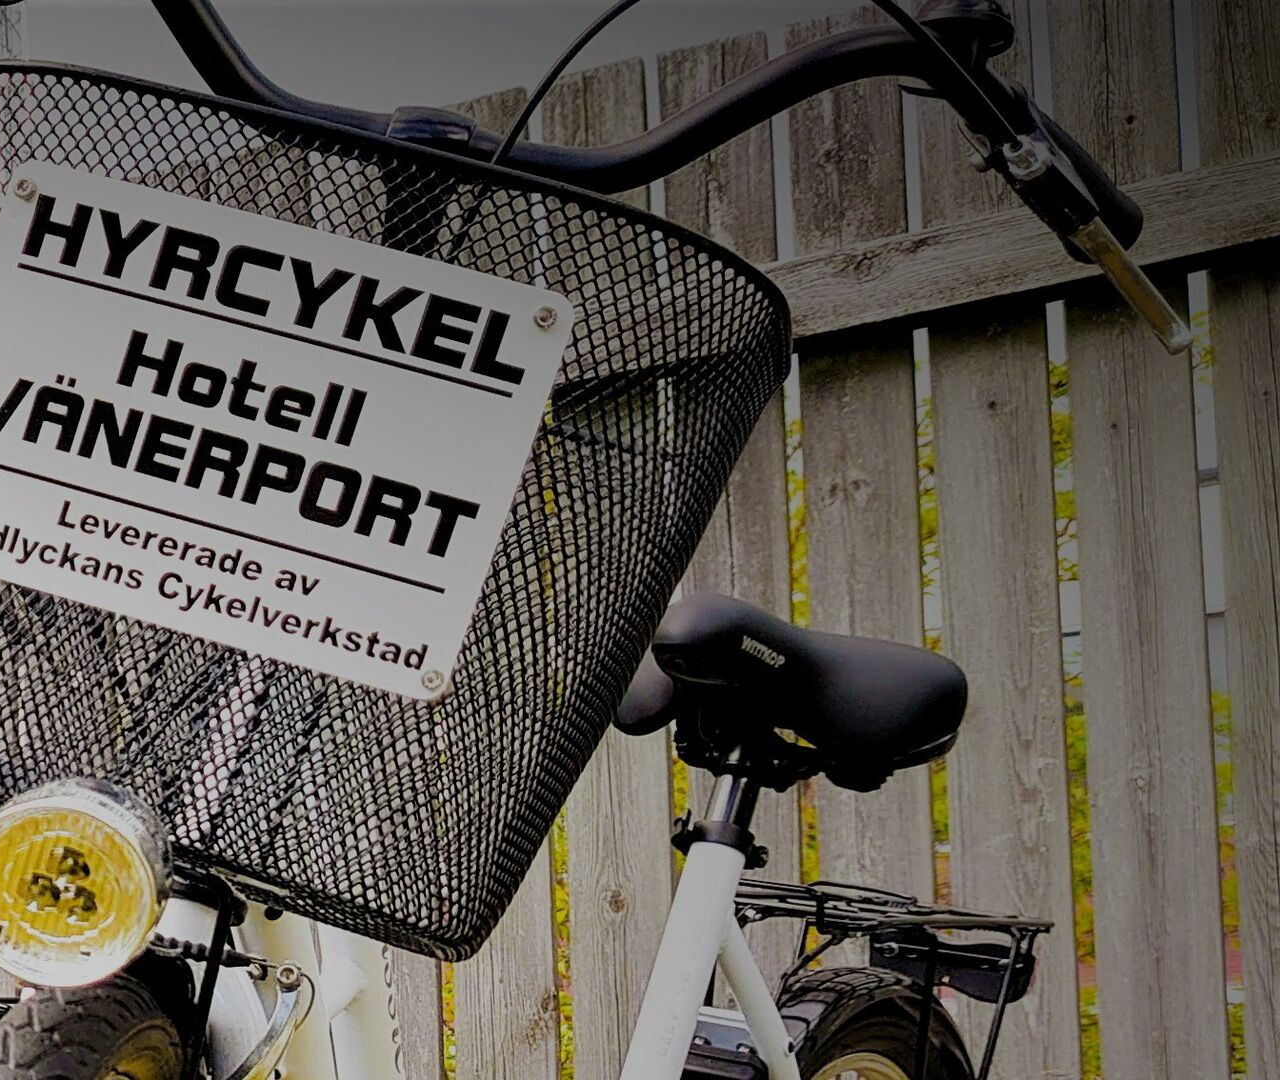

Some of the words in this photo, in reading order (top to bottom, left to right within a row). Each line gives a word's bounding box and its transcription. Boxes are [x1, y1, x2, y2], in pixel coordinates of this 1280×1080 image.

[23, 194, 526, 385] HYRCYKEL
[116, 330, 367, 447] Hotell
[58, 502, 262, 580] Levererade
[275, 570, 320, 595] av
[158, 573, 428, 670] Cykelverkstad
